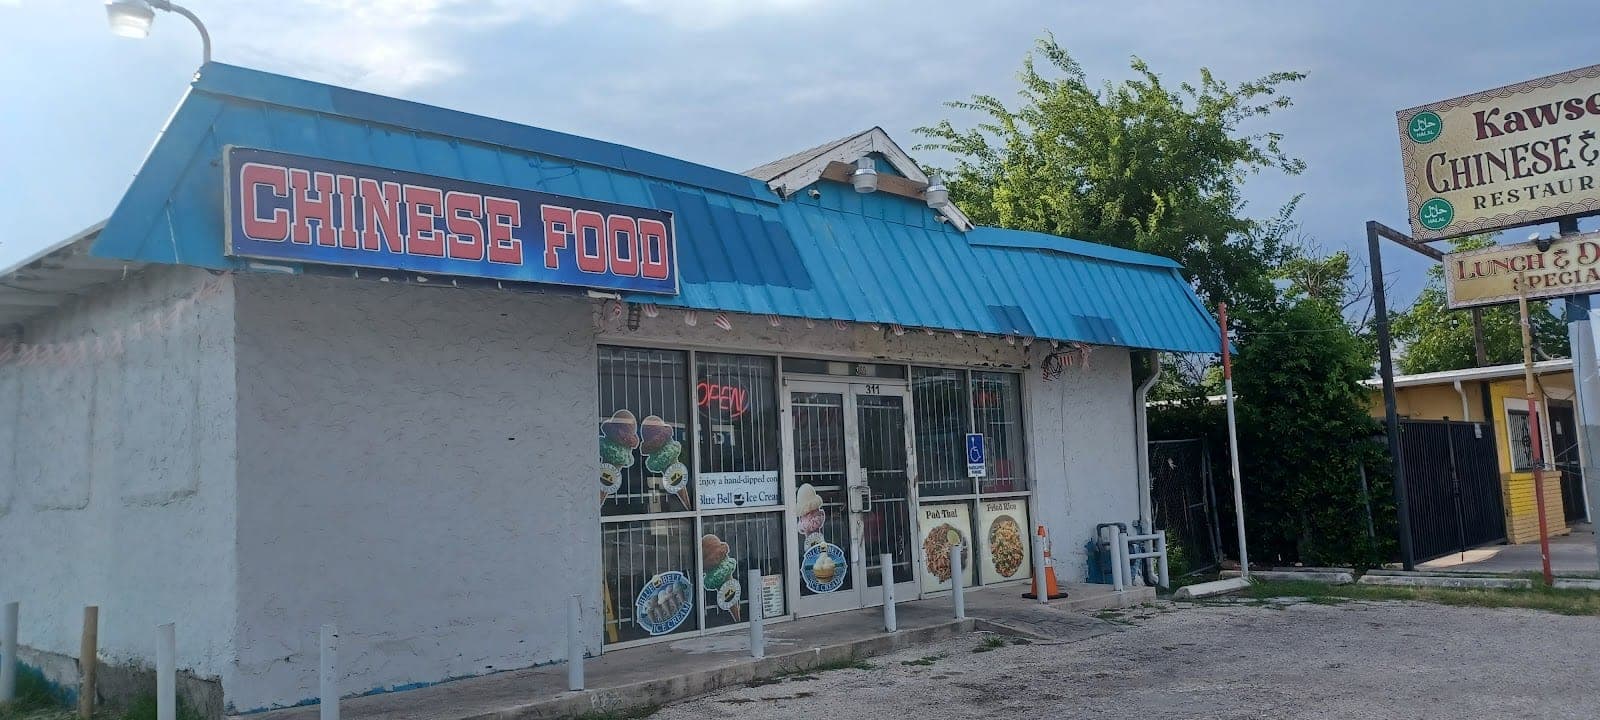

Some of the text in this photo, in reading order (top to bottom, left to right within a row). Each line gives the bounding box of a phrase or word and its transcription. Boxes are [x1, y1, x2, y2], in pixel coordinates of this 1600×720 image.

[1416, 130, 1434, 138] HALAL
[1425, 130, 1599, 194] CHINESE &
[239, 161, 670, 281] CHINESE FOOD
[1427, 217, 1446, 225] HALAL
[1457, 252, 1545, 281] LUNCH
[1554, 249, 1570, 269] &
[865, 384, 880, 395] 311
[697, 382, 747, 417] OPEN
[724, 474, 765, 485] hand-dipped
[717, 492, 733, 504] Bell
[746, 491, 757, 502] Ice
[926, 510, 941, 519] Pad
[661, 574, 681, 585] BELL
[652, 600, 690, 633] ICE CREAM
